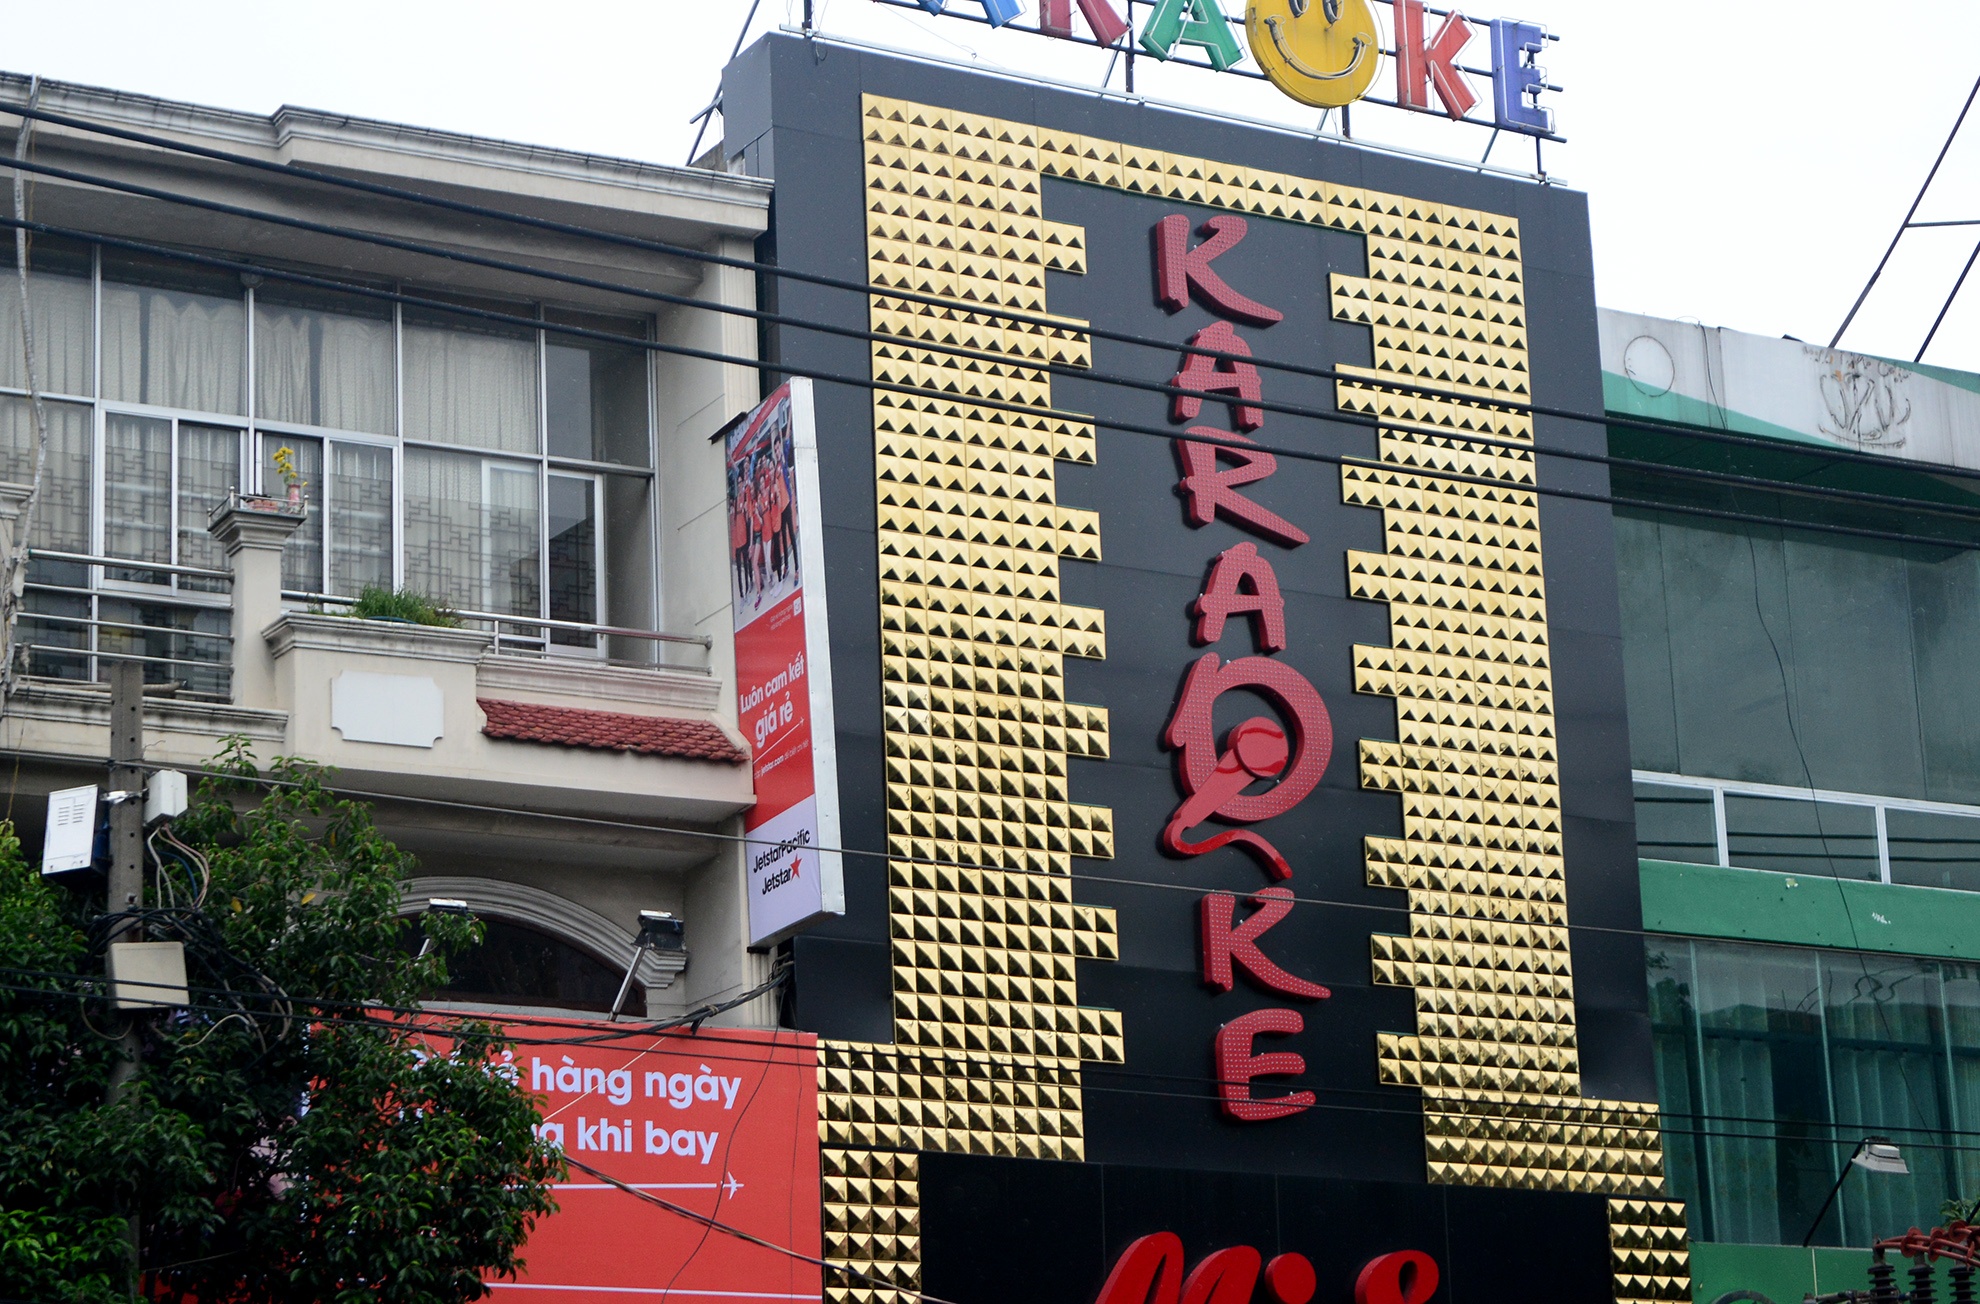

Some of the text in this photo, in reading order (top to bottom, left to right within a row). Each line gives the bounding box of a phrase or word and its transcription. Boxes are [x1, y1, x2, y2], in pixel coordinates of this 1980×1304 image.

[740, 651, 805, 714] Luôn cam kết
[1156, 213, 1334, 1122] KARAOKE
[755, 691, 793, 749] giá rẻ
[753, 828, 811, 873] JetstarPacific
[762, 868, 792, 895] Jetstar
[532, 1055, 633, 1106] hàng
[645, 1064, 742, 1110] ngày
[578, 1117, 632, 1152] khi
[645, 1121, 719, 1164] bay
